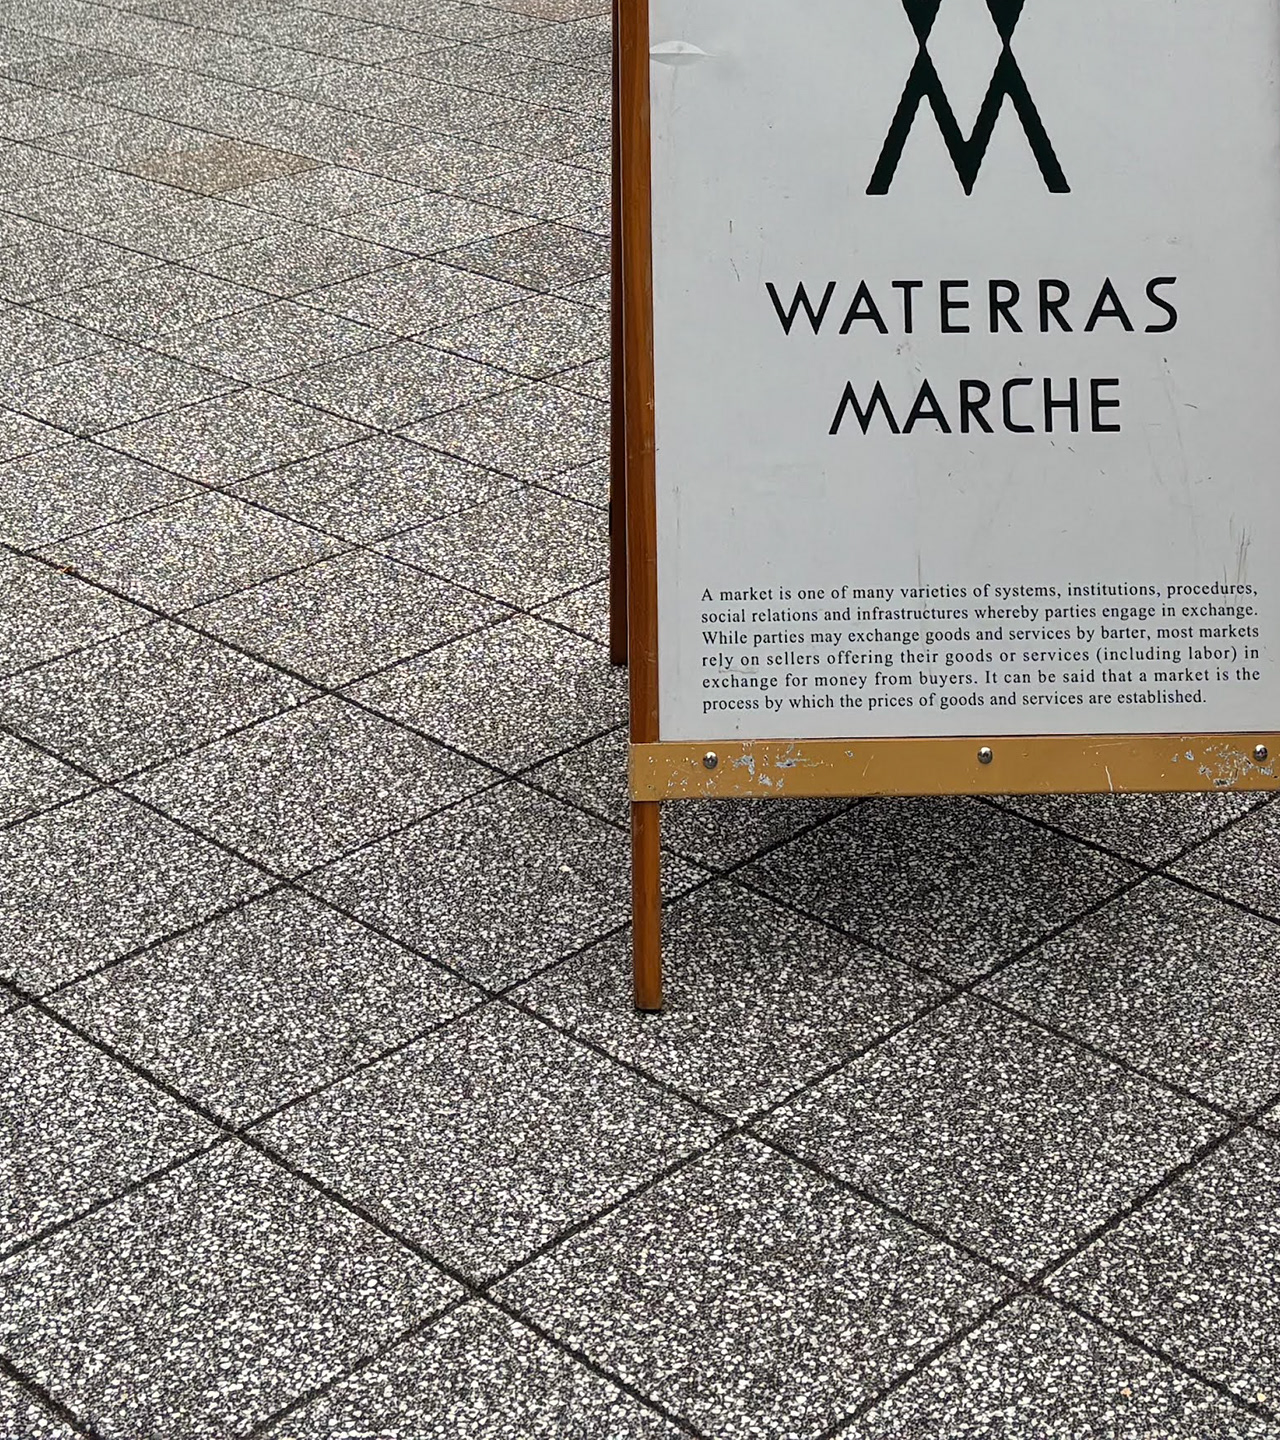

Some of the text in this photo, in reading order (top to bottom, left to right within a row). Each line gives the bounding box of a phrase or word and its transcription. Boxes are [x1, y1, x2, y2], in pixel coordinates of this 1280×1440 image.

[765, 276, 1179, 336] WATERRAS
[828, 378, 1121, 435] MARCHE
[719, 579, 1258, 603] market many varieties systems, institutions, procedures,
[701, 600, 1258, 624] social relations infrastructures whereby parties engage exchange.
[701, 623, 1260, 649] While parties exchange goods services barter, most markets
[701, 644, 1238, 671] rely sellers offering their goods services (including labor)
[702, 667, 1210, 692] exchange money from buyers. said that market
[702, 688, 1207, 715] process prices services established.
